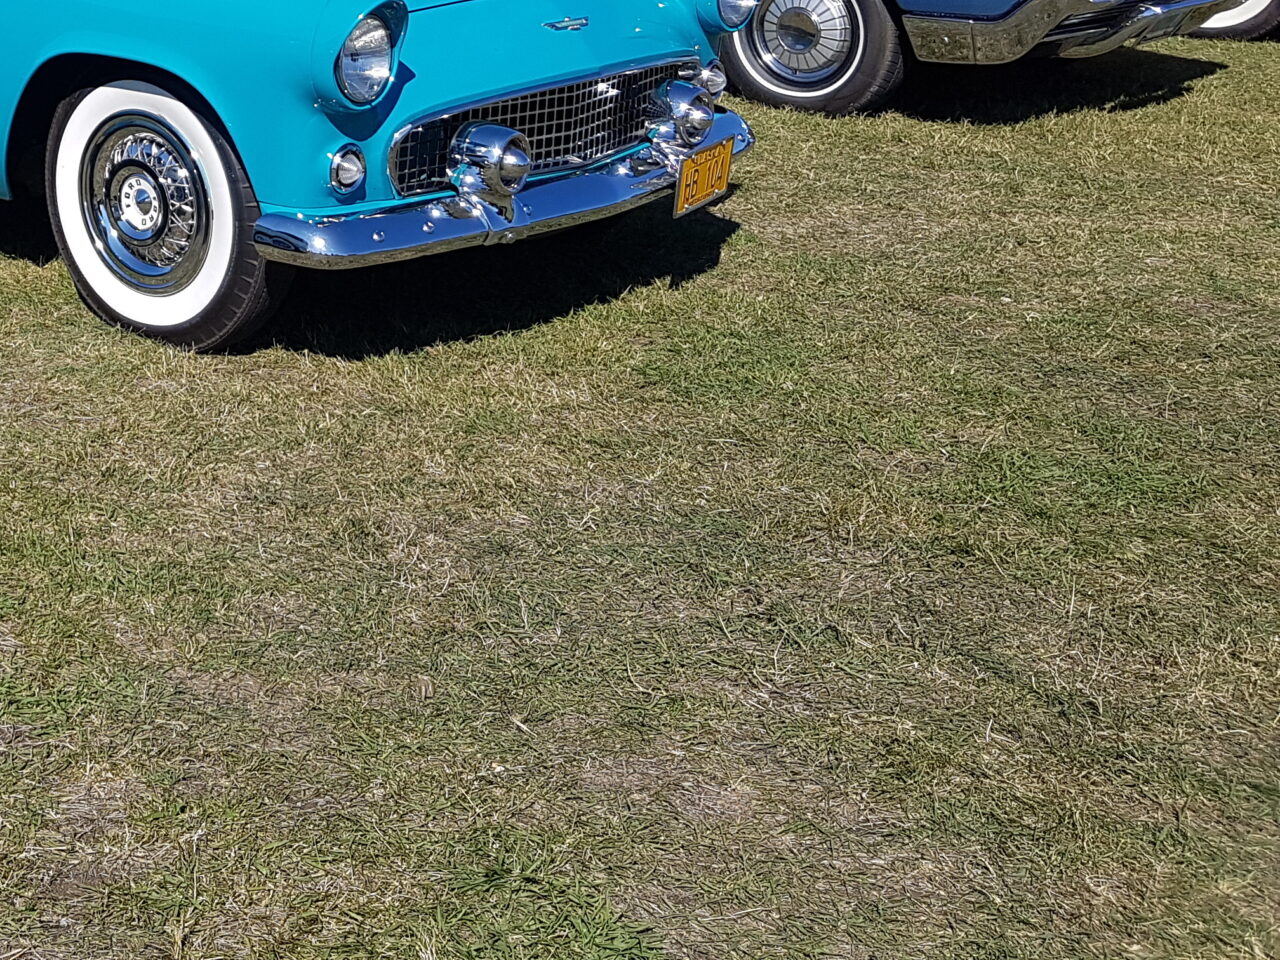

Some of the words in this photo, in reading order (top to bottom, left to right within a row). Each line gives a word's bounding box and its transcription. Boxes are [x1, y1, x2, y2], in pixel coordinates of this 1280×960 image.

[124, 179, 141, 208] FORD
[683, 168, 700, 203] HB
[705, 154, 725, 192] 104
